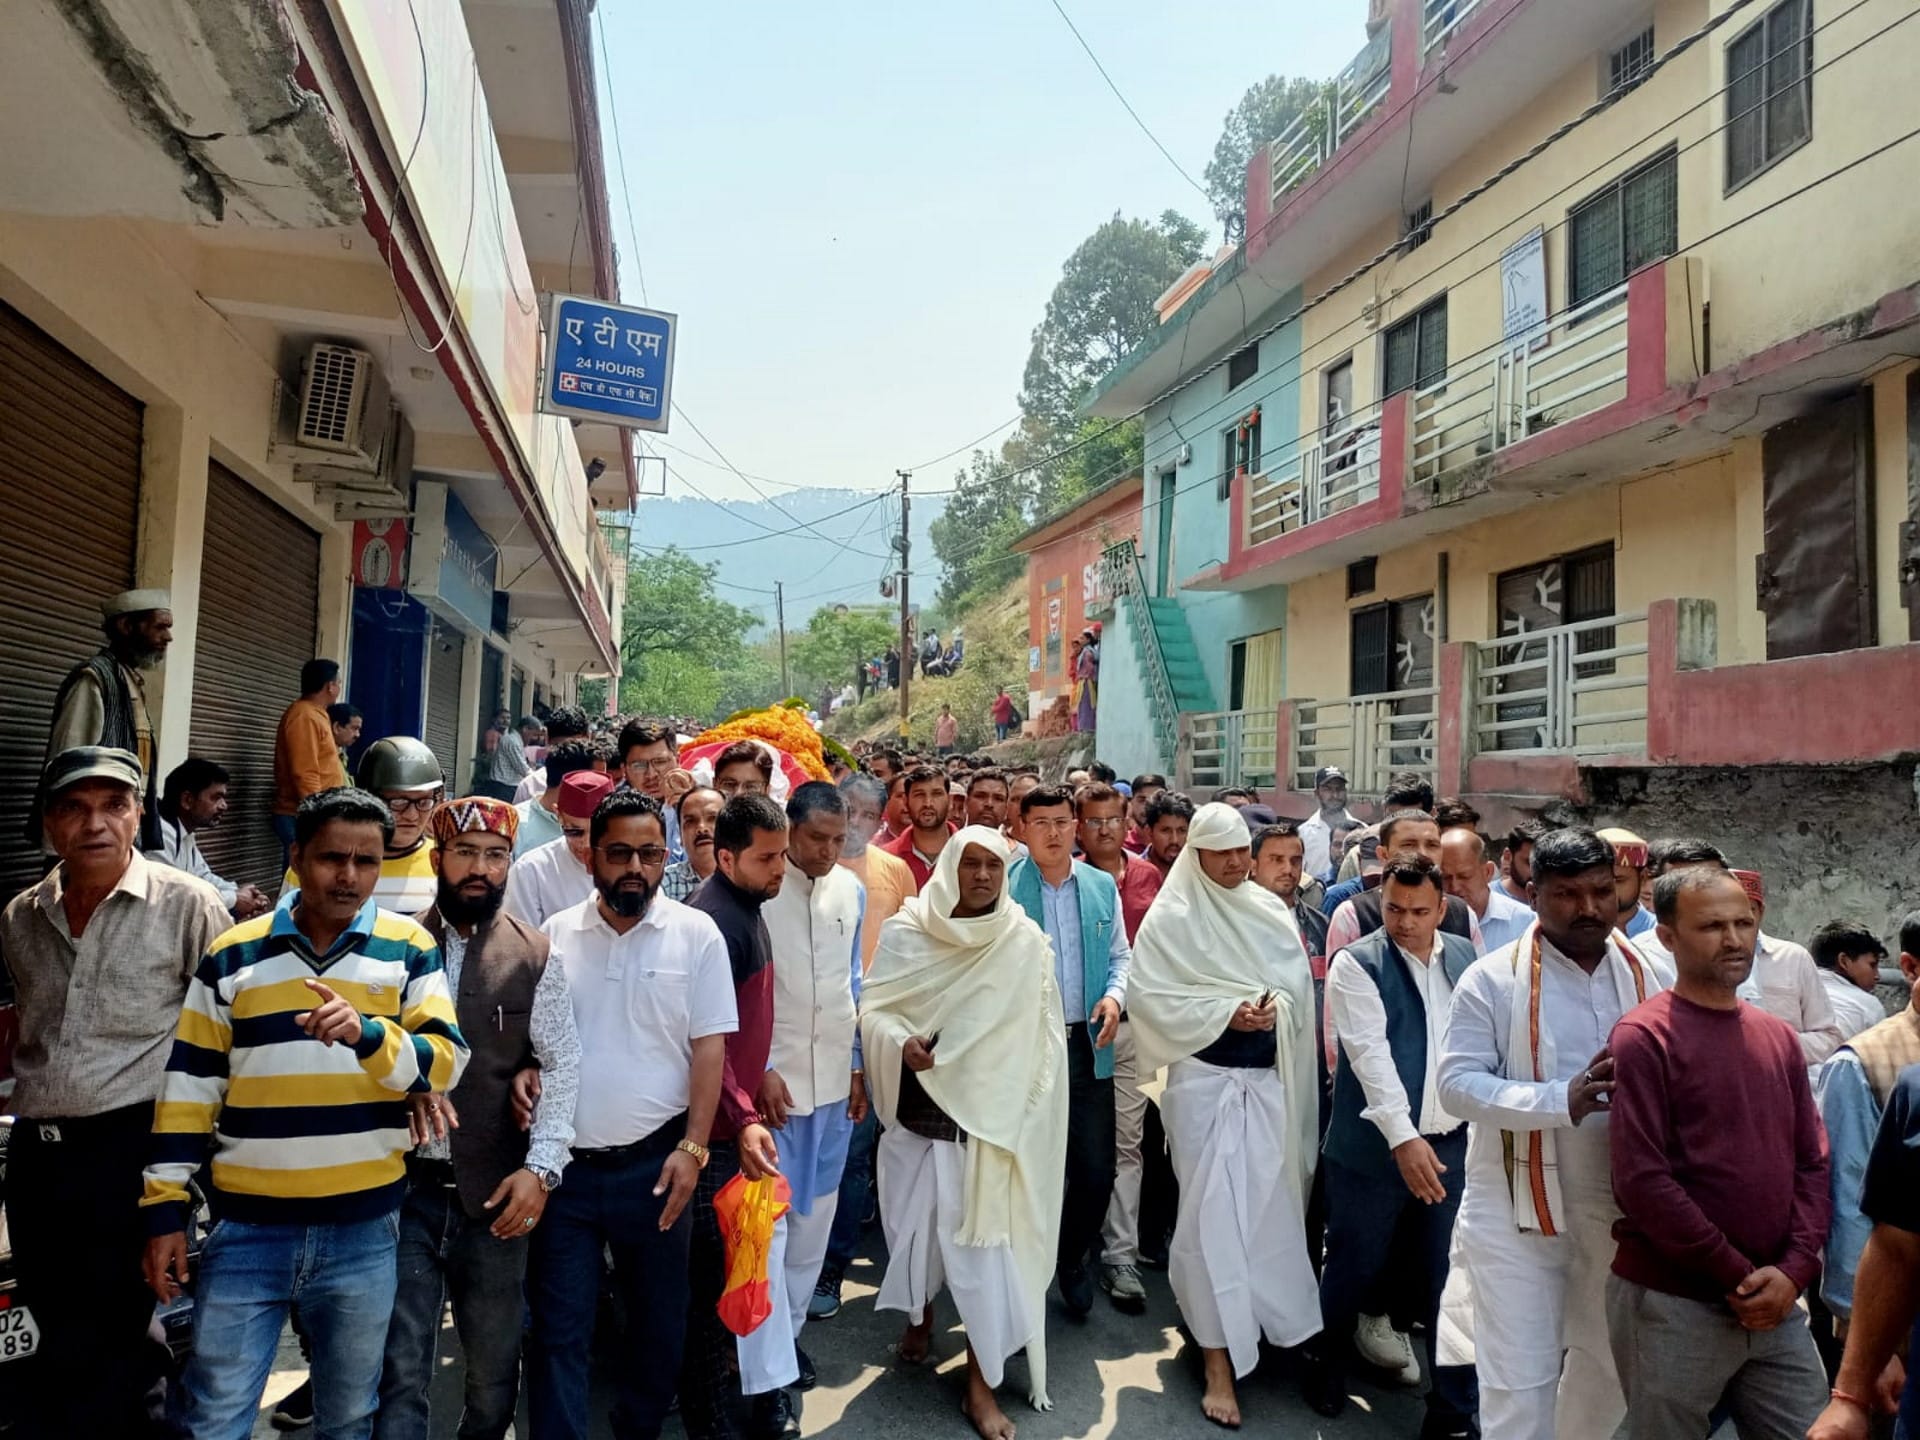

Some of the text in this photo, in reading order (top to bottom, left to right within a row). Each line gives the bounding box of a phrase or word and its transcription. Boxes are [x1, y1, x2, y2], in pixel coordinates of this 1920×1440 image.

[565, 316, 662, 358] ए टी एम
[575, 357, 645, 379] 24 HOURS
[0, 1331, 33, 1356] 89
